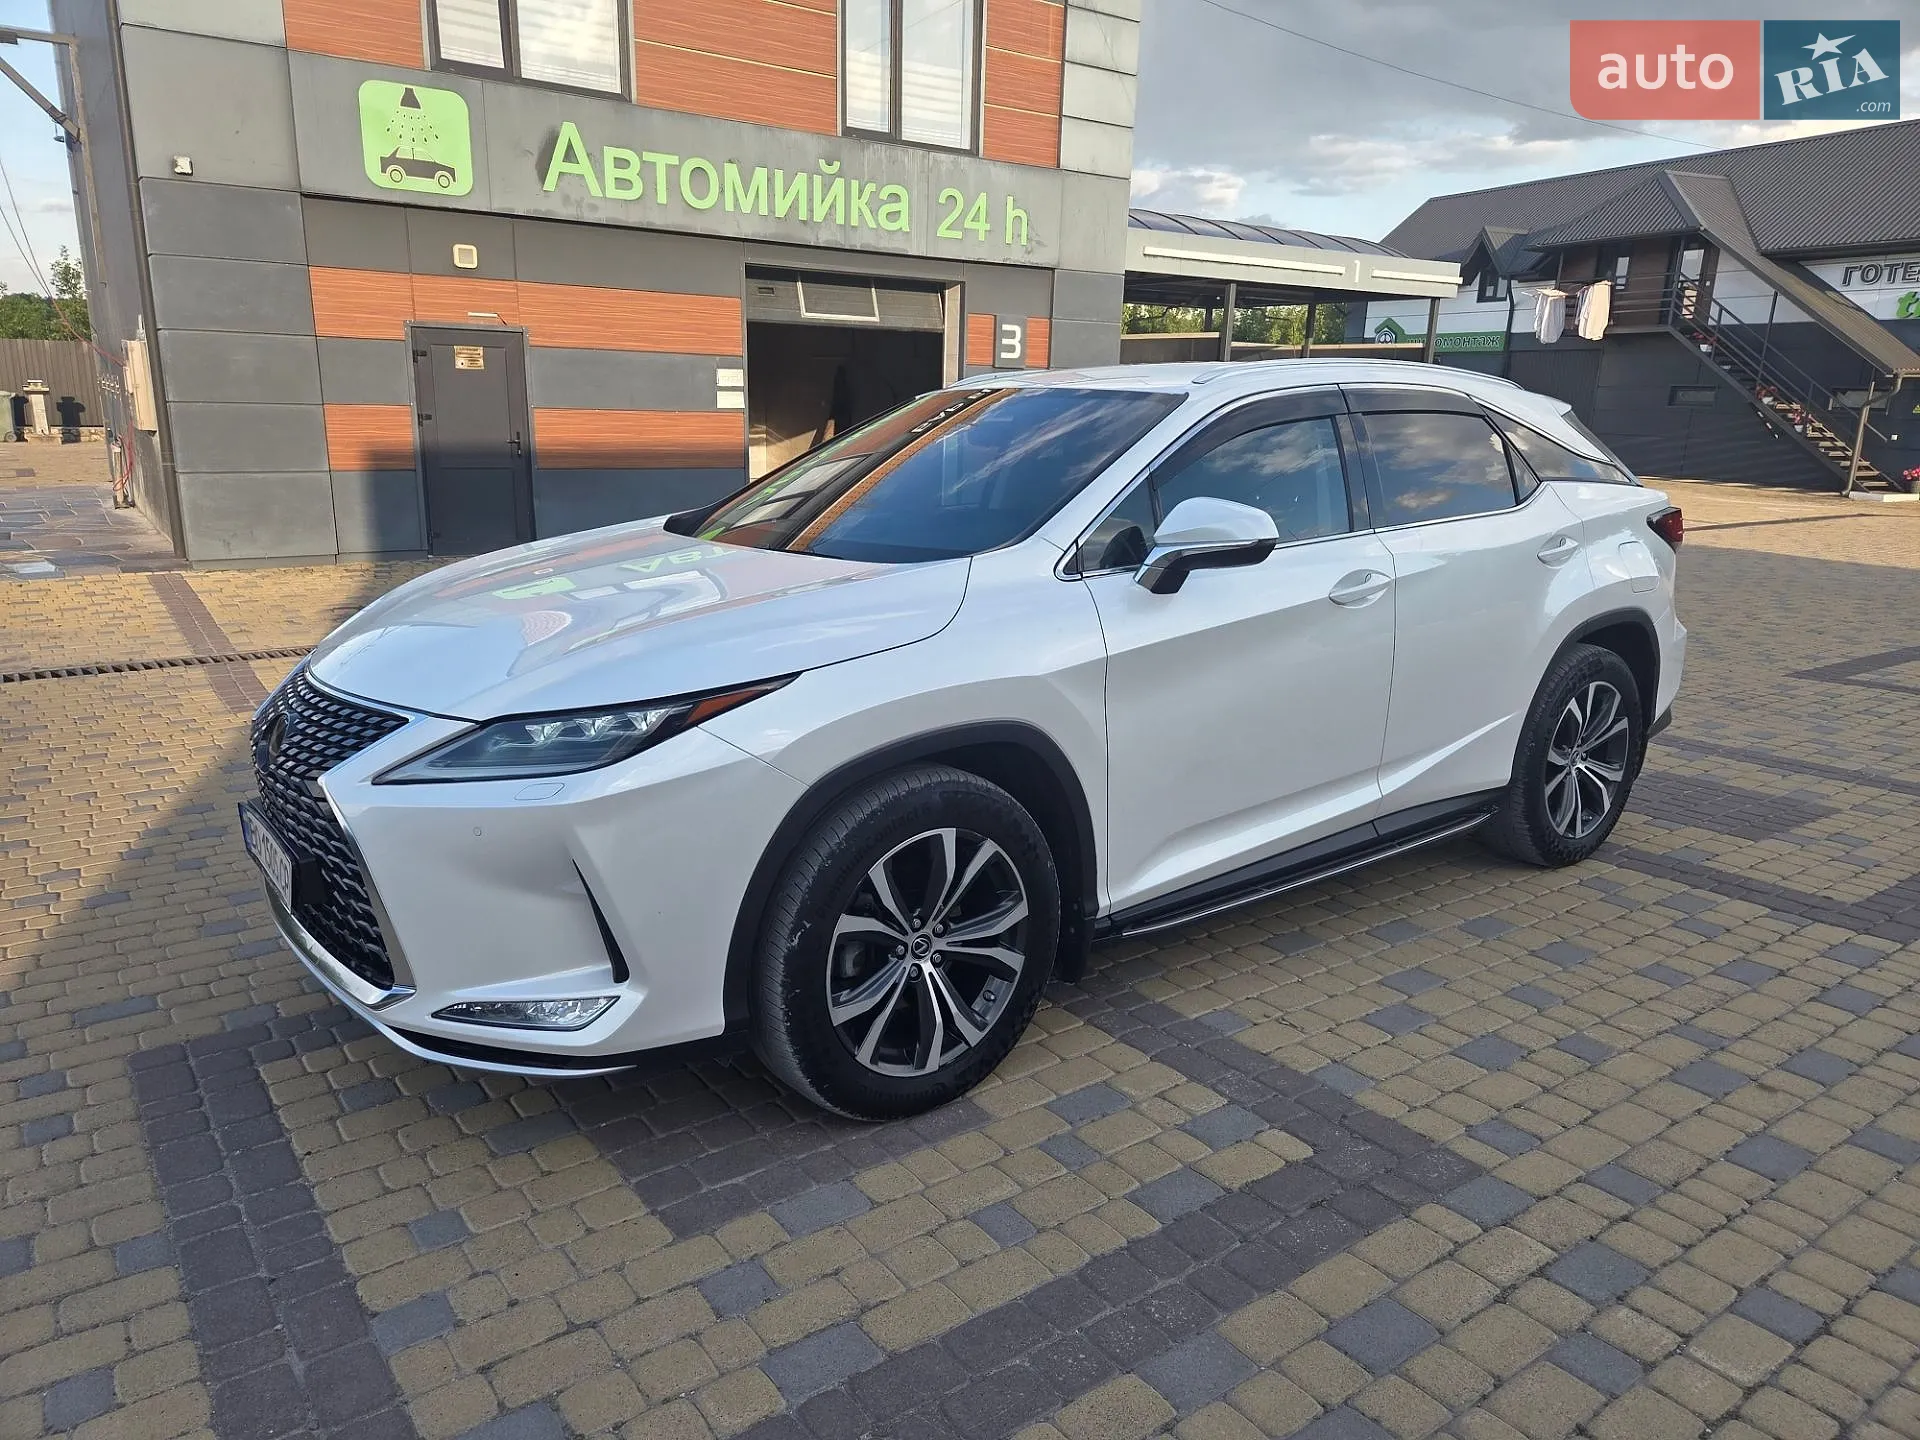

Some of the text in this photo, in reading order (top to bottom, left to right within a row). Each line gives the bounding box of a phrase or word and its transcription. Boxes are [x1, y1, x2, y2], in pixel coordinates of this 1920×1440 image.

[543, 121, 1029, 246] Автомийка 24 h
[1354, 260, 1361, 284] 1
[1842, 262, 1920, 286] ГОТЕ
[1001, 323, 1022, 359] 3
